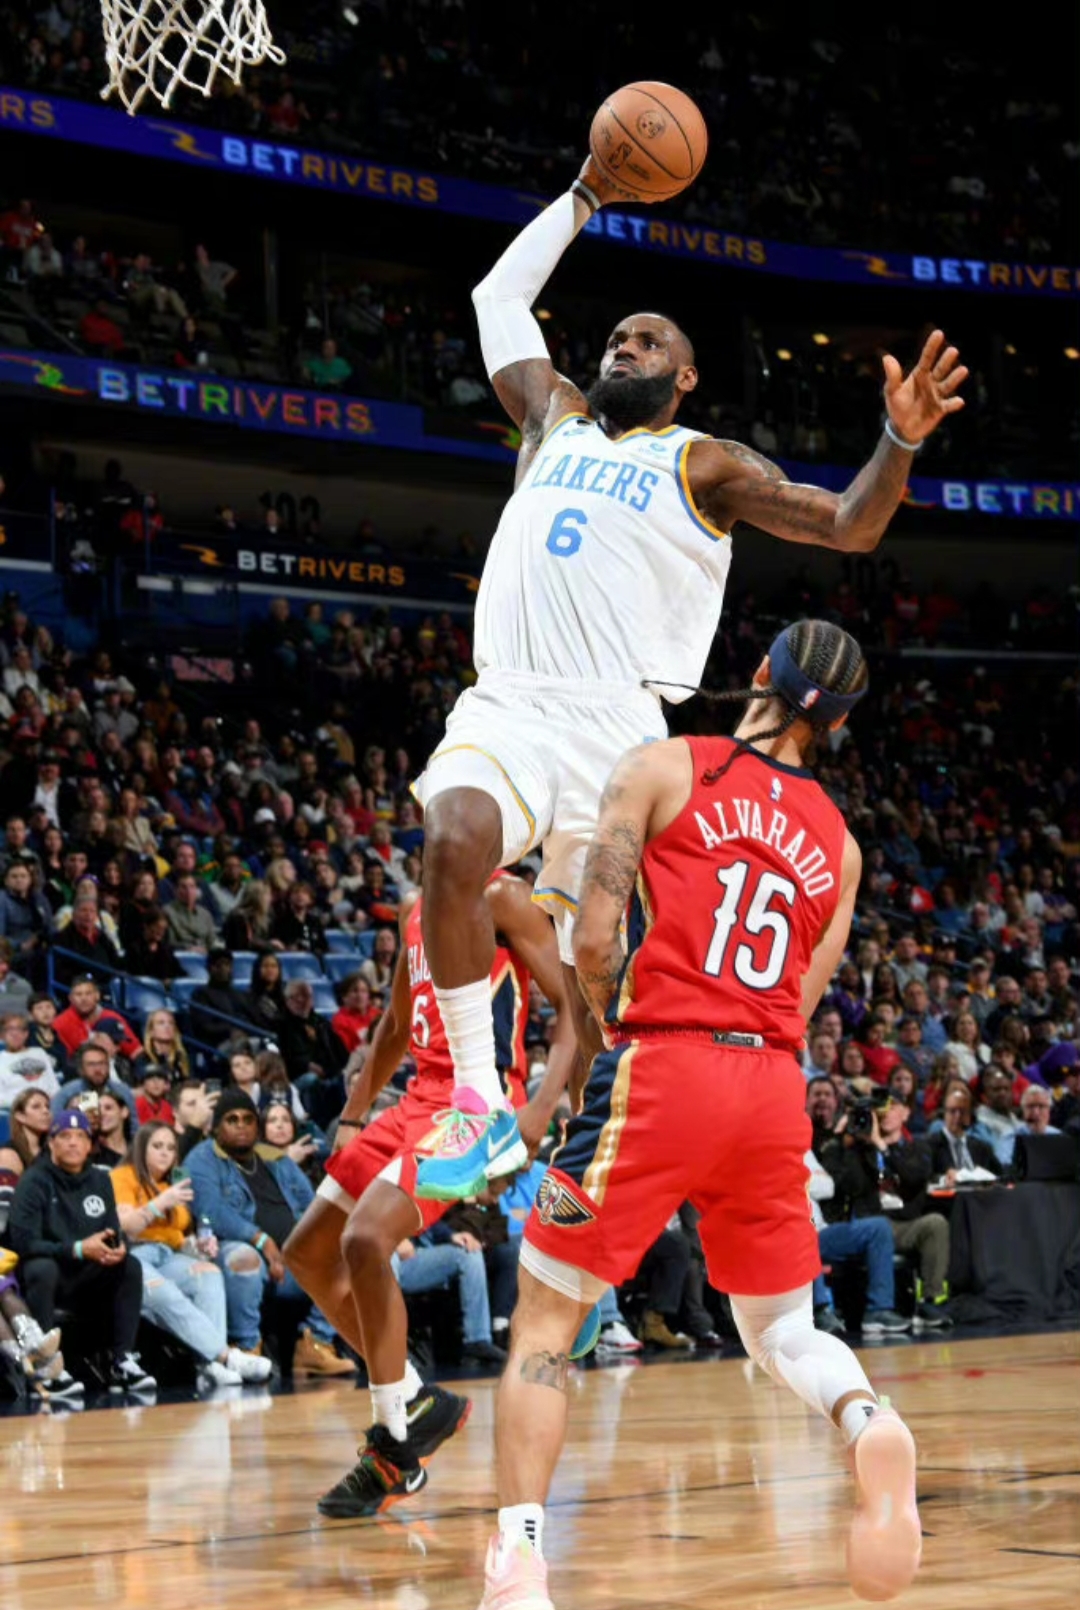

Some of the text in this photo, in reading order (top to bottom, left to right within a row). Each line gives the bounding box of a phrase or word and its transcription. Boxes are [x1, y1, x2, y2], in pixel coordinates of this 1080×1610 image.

[222, 137, 439, 203] BETRIVERS
[912, 256, 1080, 291] BETRIVE
[98, 367, 375, 433] BETRIVERS
[530, 453, 659, 513] LAKERS
[942, 482, 1080, 515] BETRI
[545, 507, 588, 559] 6
[237, 549, 406, 587] BETRIVERS
[693, 798, 835, 898] ALVARADO
[703, 858, 798, 991] 15
